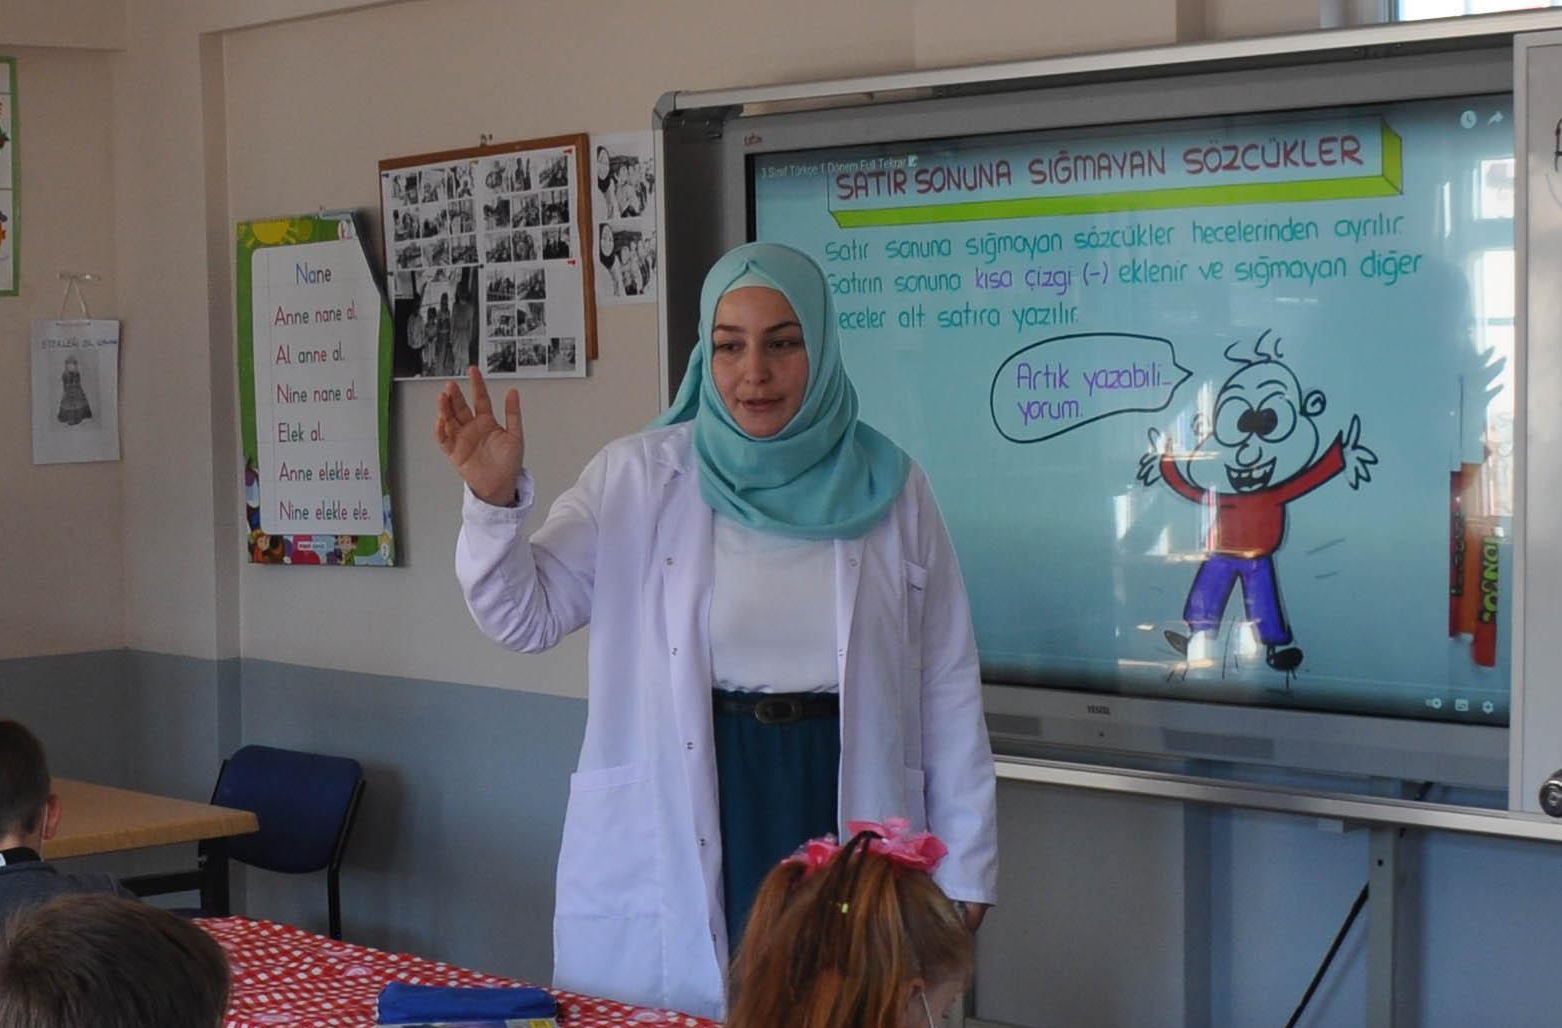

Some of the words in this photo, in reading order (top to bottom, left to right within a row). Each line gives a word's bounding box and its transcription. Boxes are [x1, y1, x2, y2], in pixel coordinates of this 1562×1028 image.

[837, 170, 908, 200] SATIR
[915, 160, 1011, 194] SONUNA
[1028, 149, 1165, 185] SIĞMAYAN
[1183, 135, 1364, 175] SÖZCÜKLER
[885, 238, 951, 259] sonuna
[965, 232, 1063, 264] sığmayan
[1074, 222, 1175, 249] sözcükler
[1192, 216, 1319, 244] hecelerinden
[295, 261, 331, 285] Nane
[894, 272, 961, 293] sonuna
[975, 268, 1013, 289] kısa
[1025, 269, 1071, 296] çizgi
[1082, 262, 1109, 287] (-)
[1118, 258, 1187, 285] eklenir
[1199, 261, 1224, 281] ve
[1234, 255, 1347, 288] sığmayan
[1360, 250, 1423, 286] diğer
[274, 306, 309, 325] Anne
[315, 310, 342, 322] nane
[838, 307, 886, 330] eceler
[898, 305, 925, 328] alt
[938, 301, 1000, 328] satıra
[276, 344, 291, 364] Al
[298, 350, 327, 364] anne
[1017, 362, 1070, 391] Artık
[277, 383, 307, 403] Nine
[314, 388, 341, 402] nane
[278, 422, 304, 443] Elek
[279, 461, 313, 481] Anne
[319, 460, 350, 480] elekle
[279, 500, 310, 520] Nine
[316, 500, 348, 520] elekle
